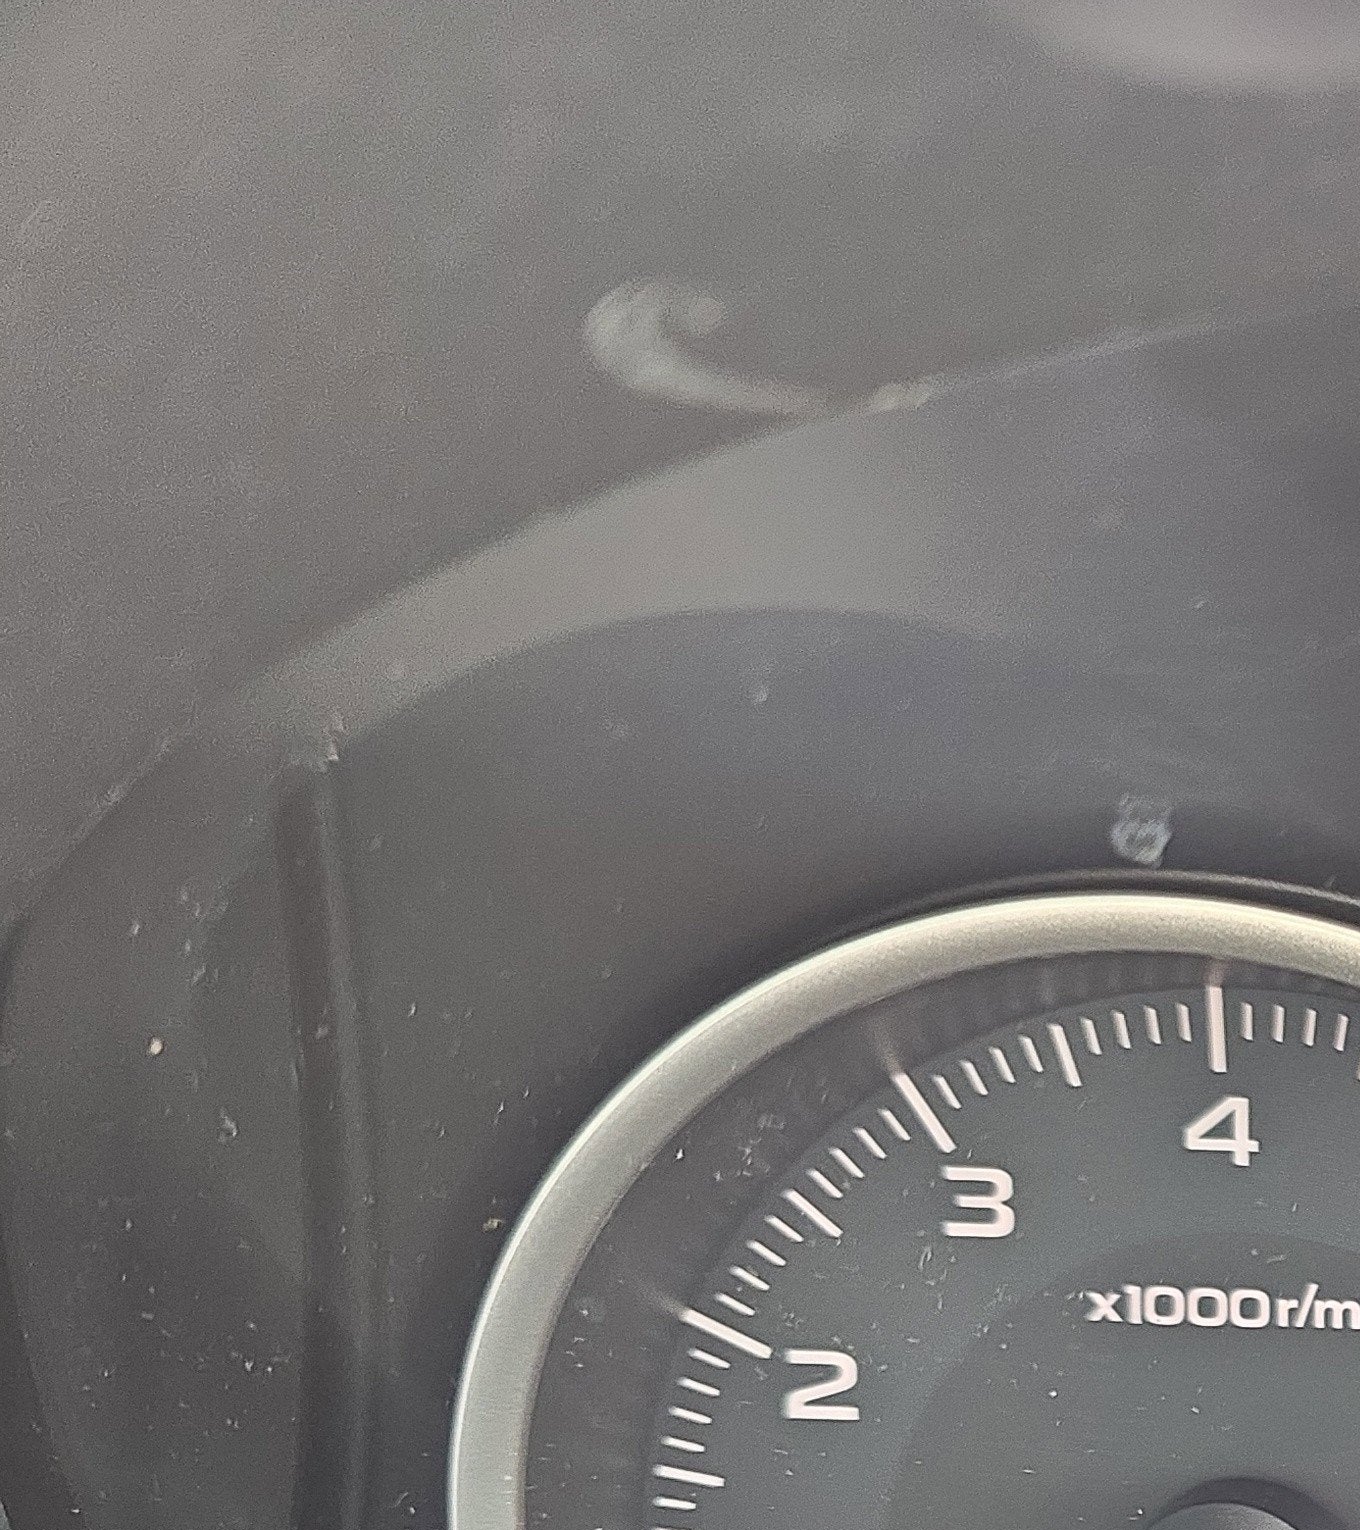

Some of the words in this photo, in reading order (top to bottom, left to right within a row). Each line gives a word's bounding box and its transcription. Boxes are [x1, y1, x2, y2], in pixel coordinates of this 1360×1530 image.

[1183, 1097, 1260, 1167] 4
[938, 1165, 1015, 1238] 3
[782, 1349, 859, 1421] 2
